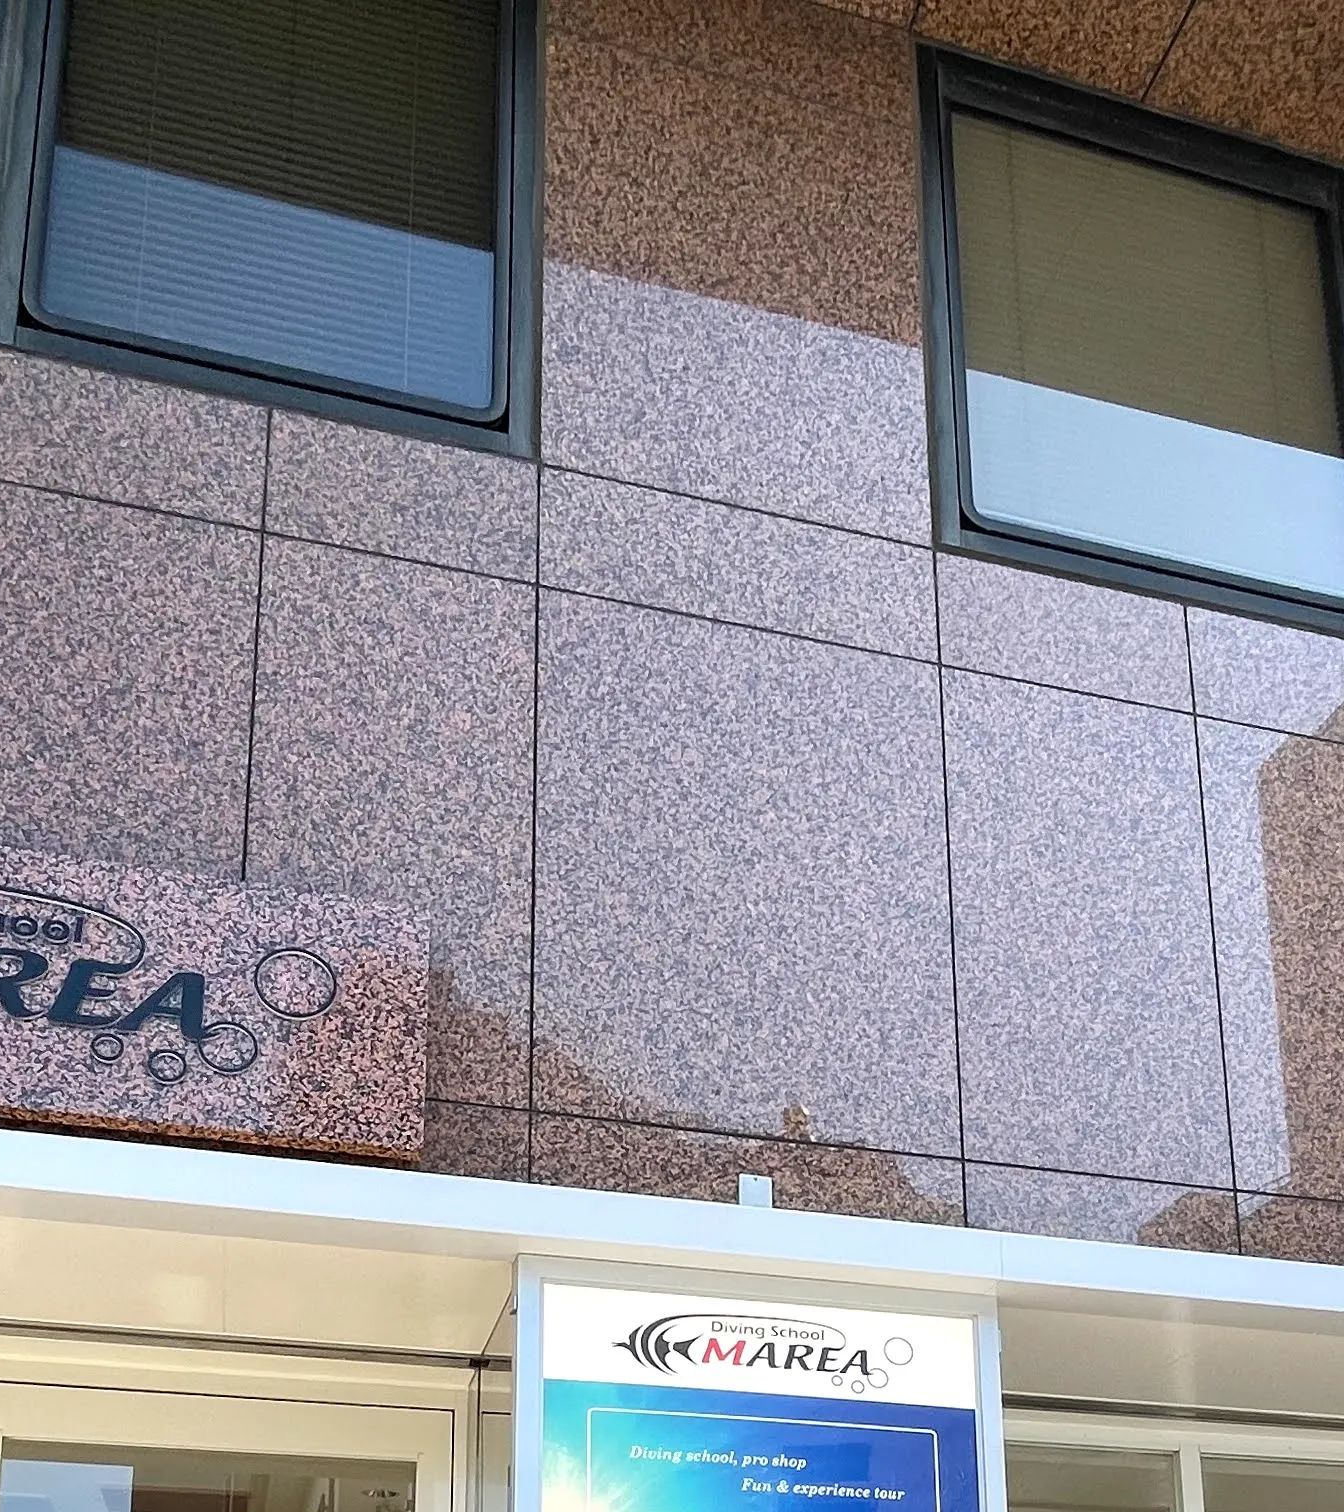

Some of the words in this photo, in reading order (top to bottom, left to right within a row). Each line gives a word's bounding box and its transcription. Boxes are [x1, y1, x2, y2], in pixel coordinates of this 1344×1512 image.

[711, 1320, 765, 1340] Diving
[770, 1323, 825, 1341] School
[701, 1337, 874, 1376] MAREA
[630, 1445, 683, 1465] Diving
[686, 1449, 739, 1467] school,
[742, 1455, 769, 1469] pro
[772, 1454, 808, 1471] shop
[741, 1478, 772, 1494] Fun
[776, 1480, 790, 1494] &
[793, 1482, 871, 1500] experience
[874, 1486, 906, 1502] tour
